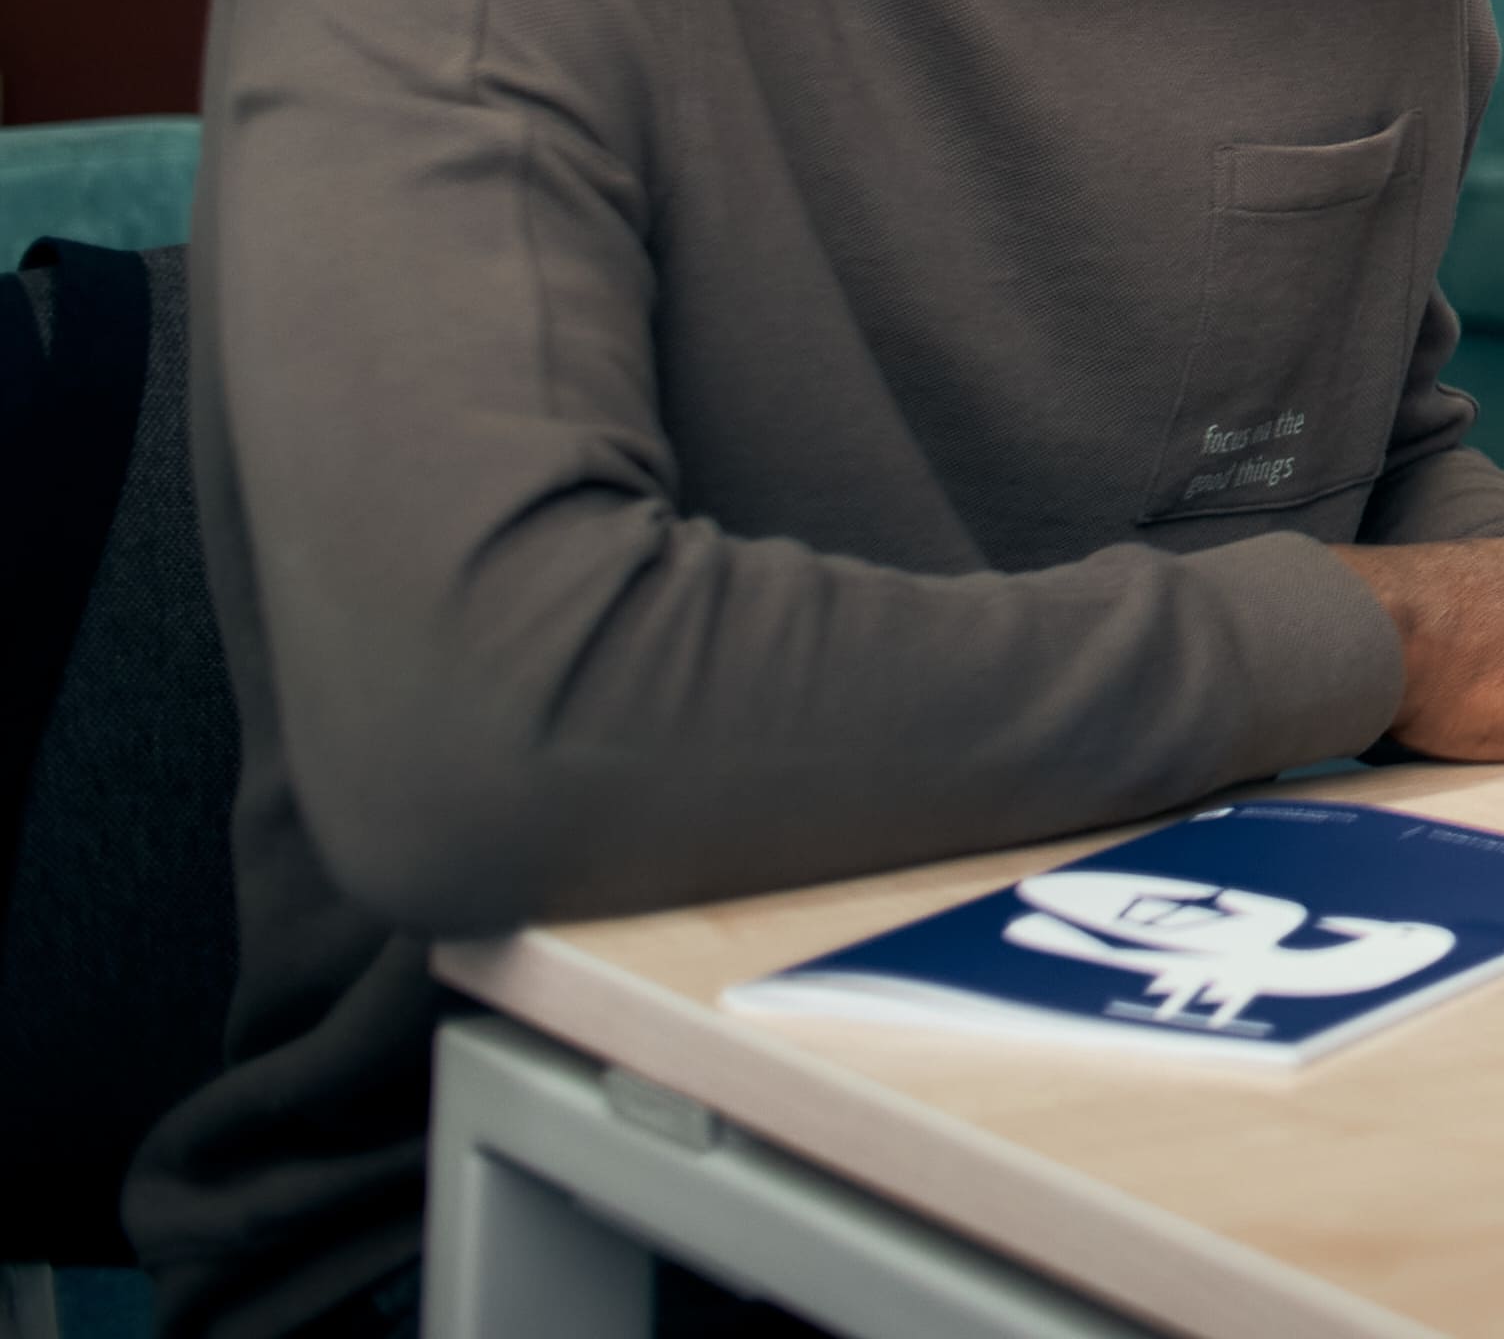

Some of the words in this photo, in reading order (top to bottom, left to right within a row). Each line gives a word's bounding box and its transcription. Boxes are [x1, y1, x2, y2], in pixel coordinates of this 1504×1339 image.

[1200, 423, 1250, 456] focus
[1274, 409, 1305, 438] the
[1184, 468, 1234, 499] good
[1233, 455, 1295, 489] things
